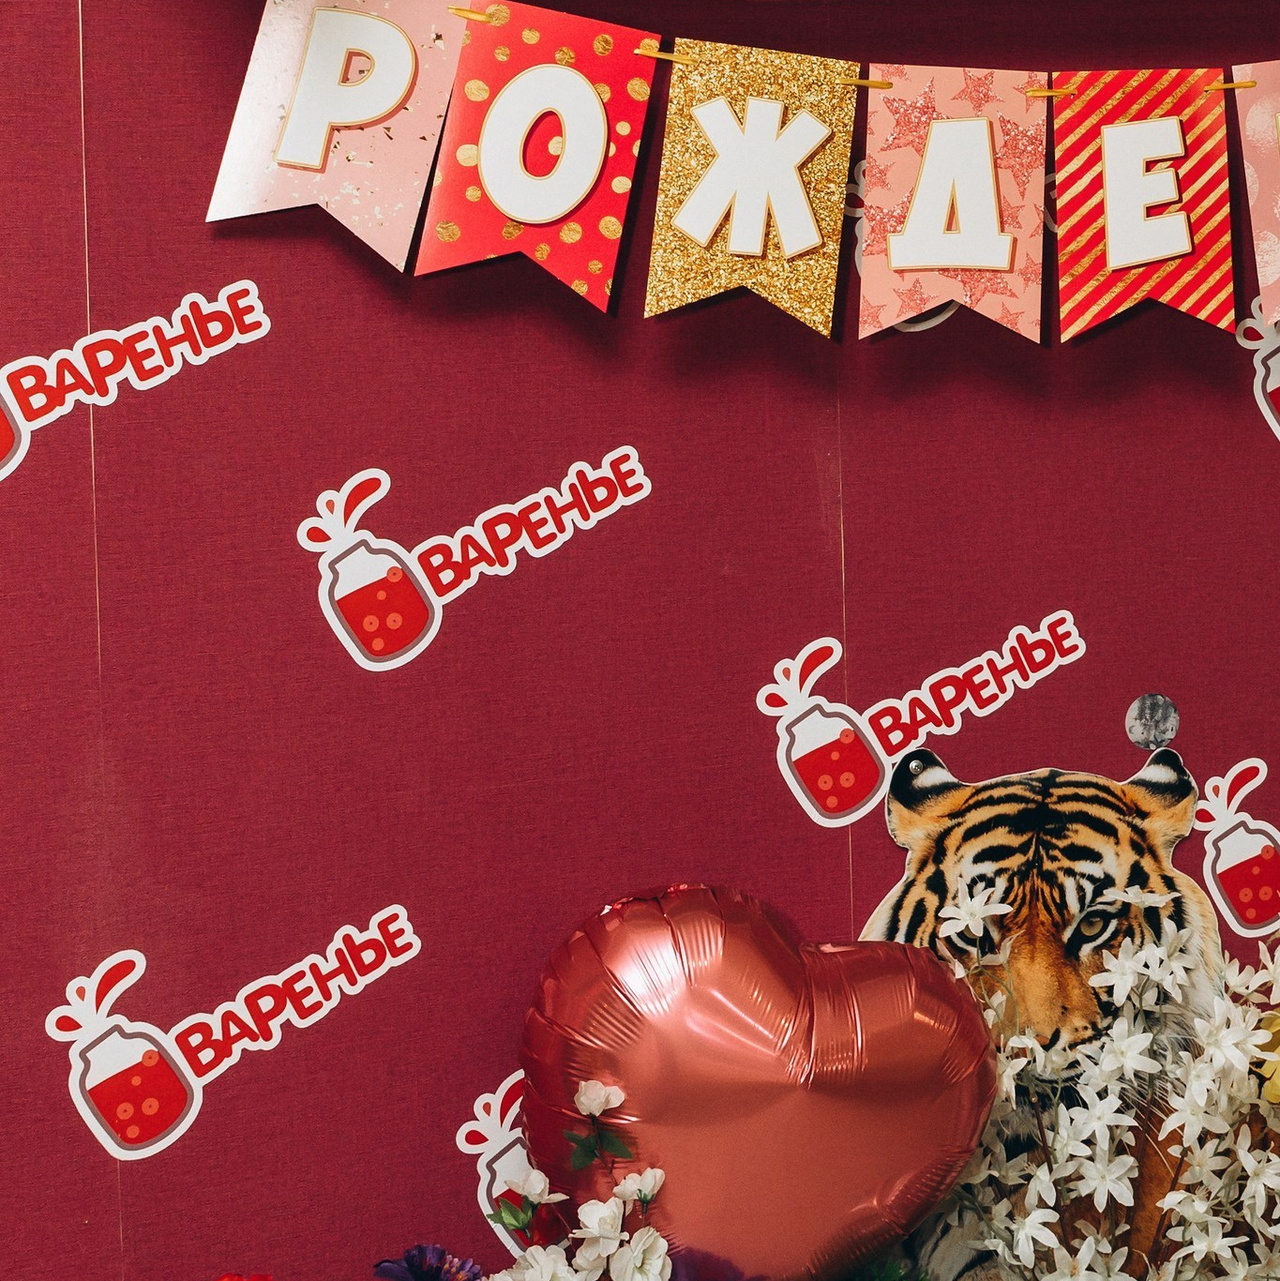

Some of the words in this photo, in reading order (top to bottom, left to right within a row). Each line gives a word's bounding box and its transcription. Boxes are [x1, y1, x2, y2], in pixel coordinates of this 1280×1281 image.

[7, 287, 262, 422] ВАРЕНЬЕ
[418, 453, 644, 598] ВАРЕНЬЕ
[868, 615, 1080, 757] ВАРЕНЬЕ
[175, 912, 414, 1078] ВАРЕНЬЕ
